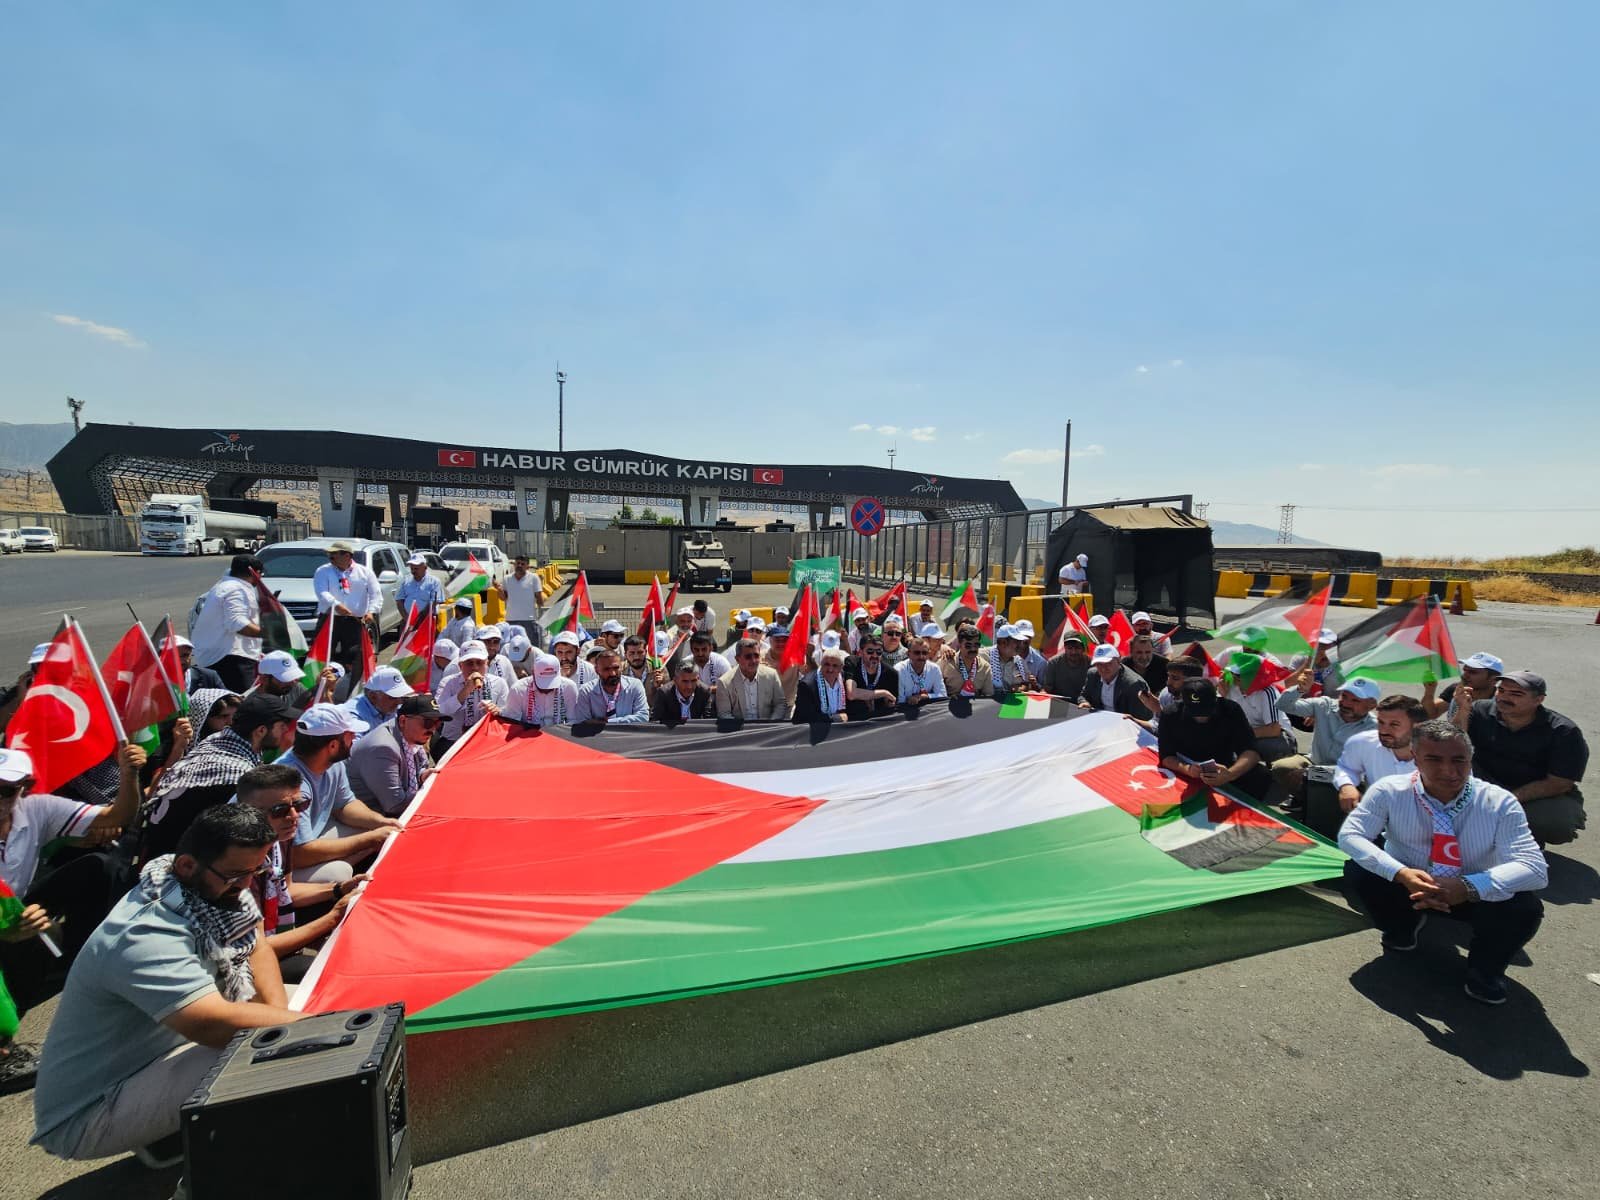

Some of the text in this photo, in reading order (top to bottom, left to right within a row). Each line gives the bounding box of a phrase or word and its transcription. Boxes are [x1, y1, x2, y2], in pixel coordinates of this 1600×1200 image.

[483, 453, 748, 482] HABUR GÜMRÜK KAPISI
